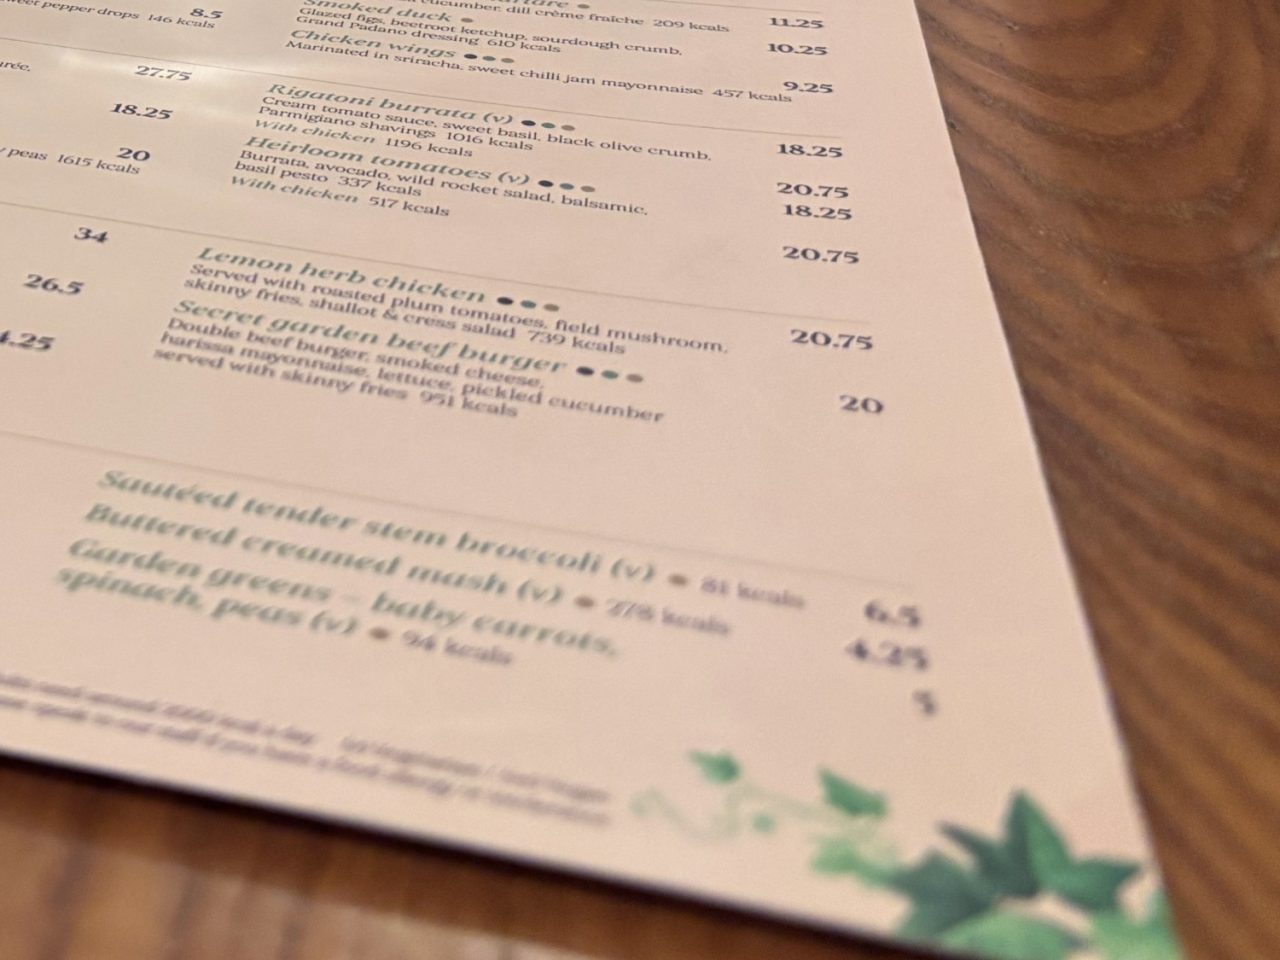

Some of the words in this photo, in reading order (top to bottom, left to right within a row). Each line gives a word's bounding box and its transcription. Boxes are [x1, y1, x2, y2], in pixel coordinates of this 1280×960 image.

[188, 7, 223, 19] 8.5
[395, 7, 451, 23] duck
[769, 16, 824, 29] 11.25
[289, 28, 382, 48] Chicken
[388, 42, 457, 58] wings
[767, 42, 828, 56] 10.25
[133, 64, 193, 81] 27.75
[284, 39, 370, 58] Marinated
[372, 50, 389, 61] in
[467, 64, 515, 76] sweet
[518, 68, 560, 81] chilli
[561, 73, 596, 85] jam
[600, 78, 704, 96] mayonnaise
[710, 87, 744, 99] 457
[747, 89, 793, 103] kcals
[782, 80, 834, 94] 9.25
[110, 102, 173, 120] 18.25
[266, 83, 376, 107] Rigatoni
[377, 97, 476, 120] burrata
[482, 111, 513, 125] (v)
[257, 104, 356, 127] Parmigiano
[359, 119, 436, 139] shavings
[446, 130, 484, 144] 1016
[487, 135, 533, 151] kcals
[261, 95, 316, 111] Cream
[320, 104, 381, 120] tomato
[441, 121, 492, 135] sweet
[546, 132, 594, 148] black
[598, 139, 643, 153] olive
[254, 118, 298, 133] With
[300, 126, 376, 144] chicken
[385, 136, 423, 150] 1196
[426, 141, 473, 157] kcals
[115, 146, 151, 162] 20
[244, 135, 364, 163] Heirloom
[369, 154, 492, 180] tomatoes
[496, 170, 530, 186] (v)
[777, 142, 843, 158] 18.25
[233, 159, 277, 176] basil
[278, 168, 329, 183] pesto
[336, 174, 373, 189] 337
[374, 179, 422, 197] kcals
[230, 174, 277, 191] With
[279, 183, 359, 203] chicken
[368, 195, 399, 209] 517
[401, 199, 450, 217] kcals
[776, 181, 849, 199] 20.75
[784, 203, 853, 221] 18.25
[72, 226, 108, 244] 34
[781, 244, 860, 264] 20.75
[22, 273, 85, 295] 26.5
[196, 246, 293, 273] Lemon
[298, 261, 366, 284] herb
[371, 274, 485, 303] chicken
[172, 299, 265, 326] Secret
[265, 318, 379, 345] garden
[385, 331, 457, 359] beef
[456, 342, 567, 373] burger
[790, 328, 873, 351] 20.75
[839, 393, 885, 415] 20
[241, 497, 357, 531] tender
[363, 520, 448, 547] stem
[454, 530, 602, 574] broccoli
[609, 557, 657, 583] (v)
